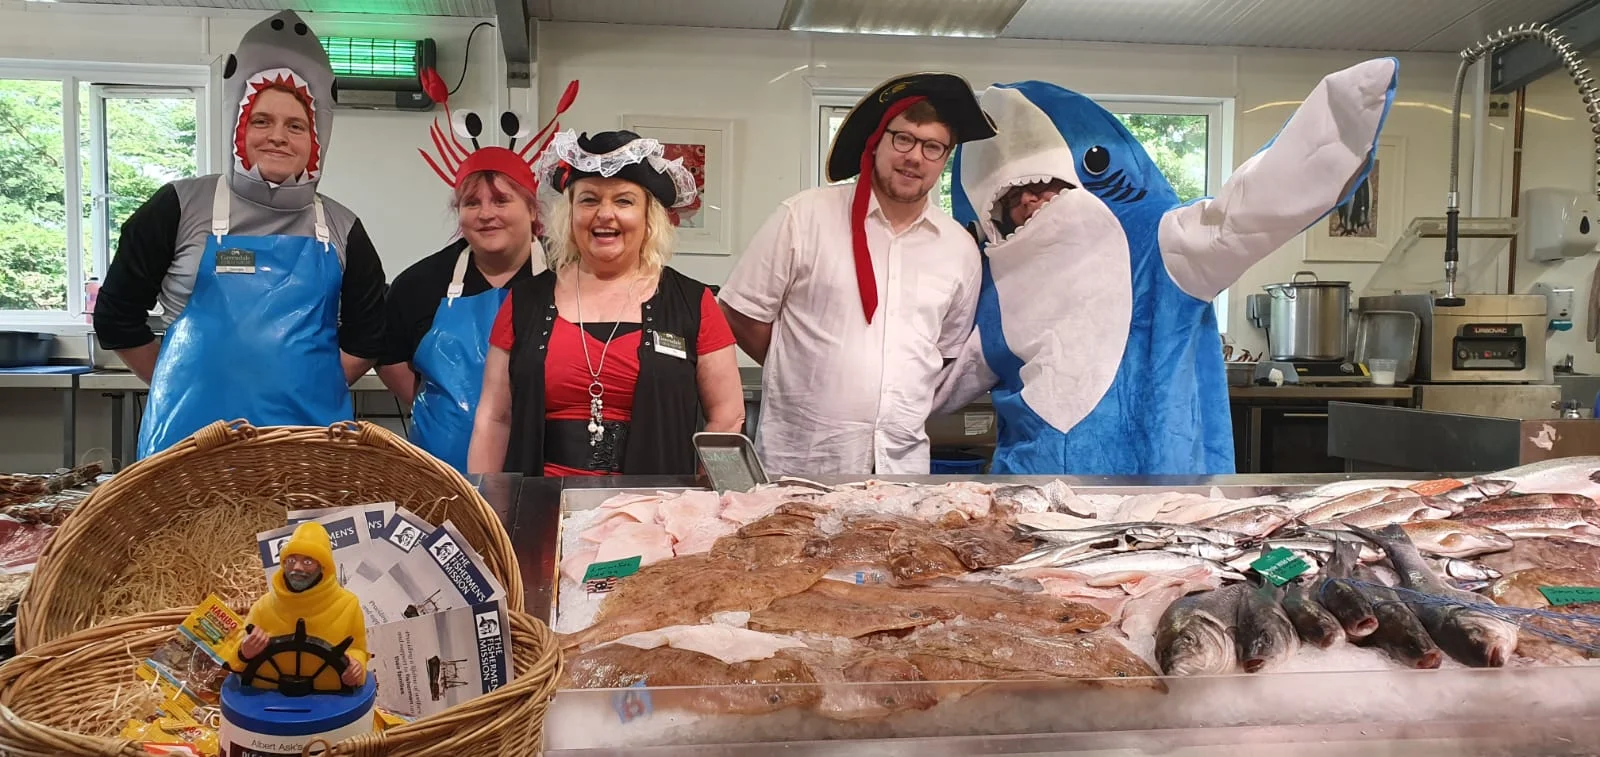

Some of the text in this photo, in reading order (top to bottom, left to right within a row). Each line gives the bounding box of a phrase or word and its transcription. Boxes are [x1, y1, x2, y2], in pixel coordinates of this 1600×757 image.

[456, 551, 471, 568] THE
[442, 562, 470, 595] MISSION
[449, 557, 486, 602] FISHERMEN'S
[210, 604, 237, 629] HARIBO
[480, 639, 491, 681] MISSION
[494, 636, 503, 656] THE
[486, 637, 499, 692] FISHERMEN
[251, 739, 276, 751] Albert
